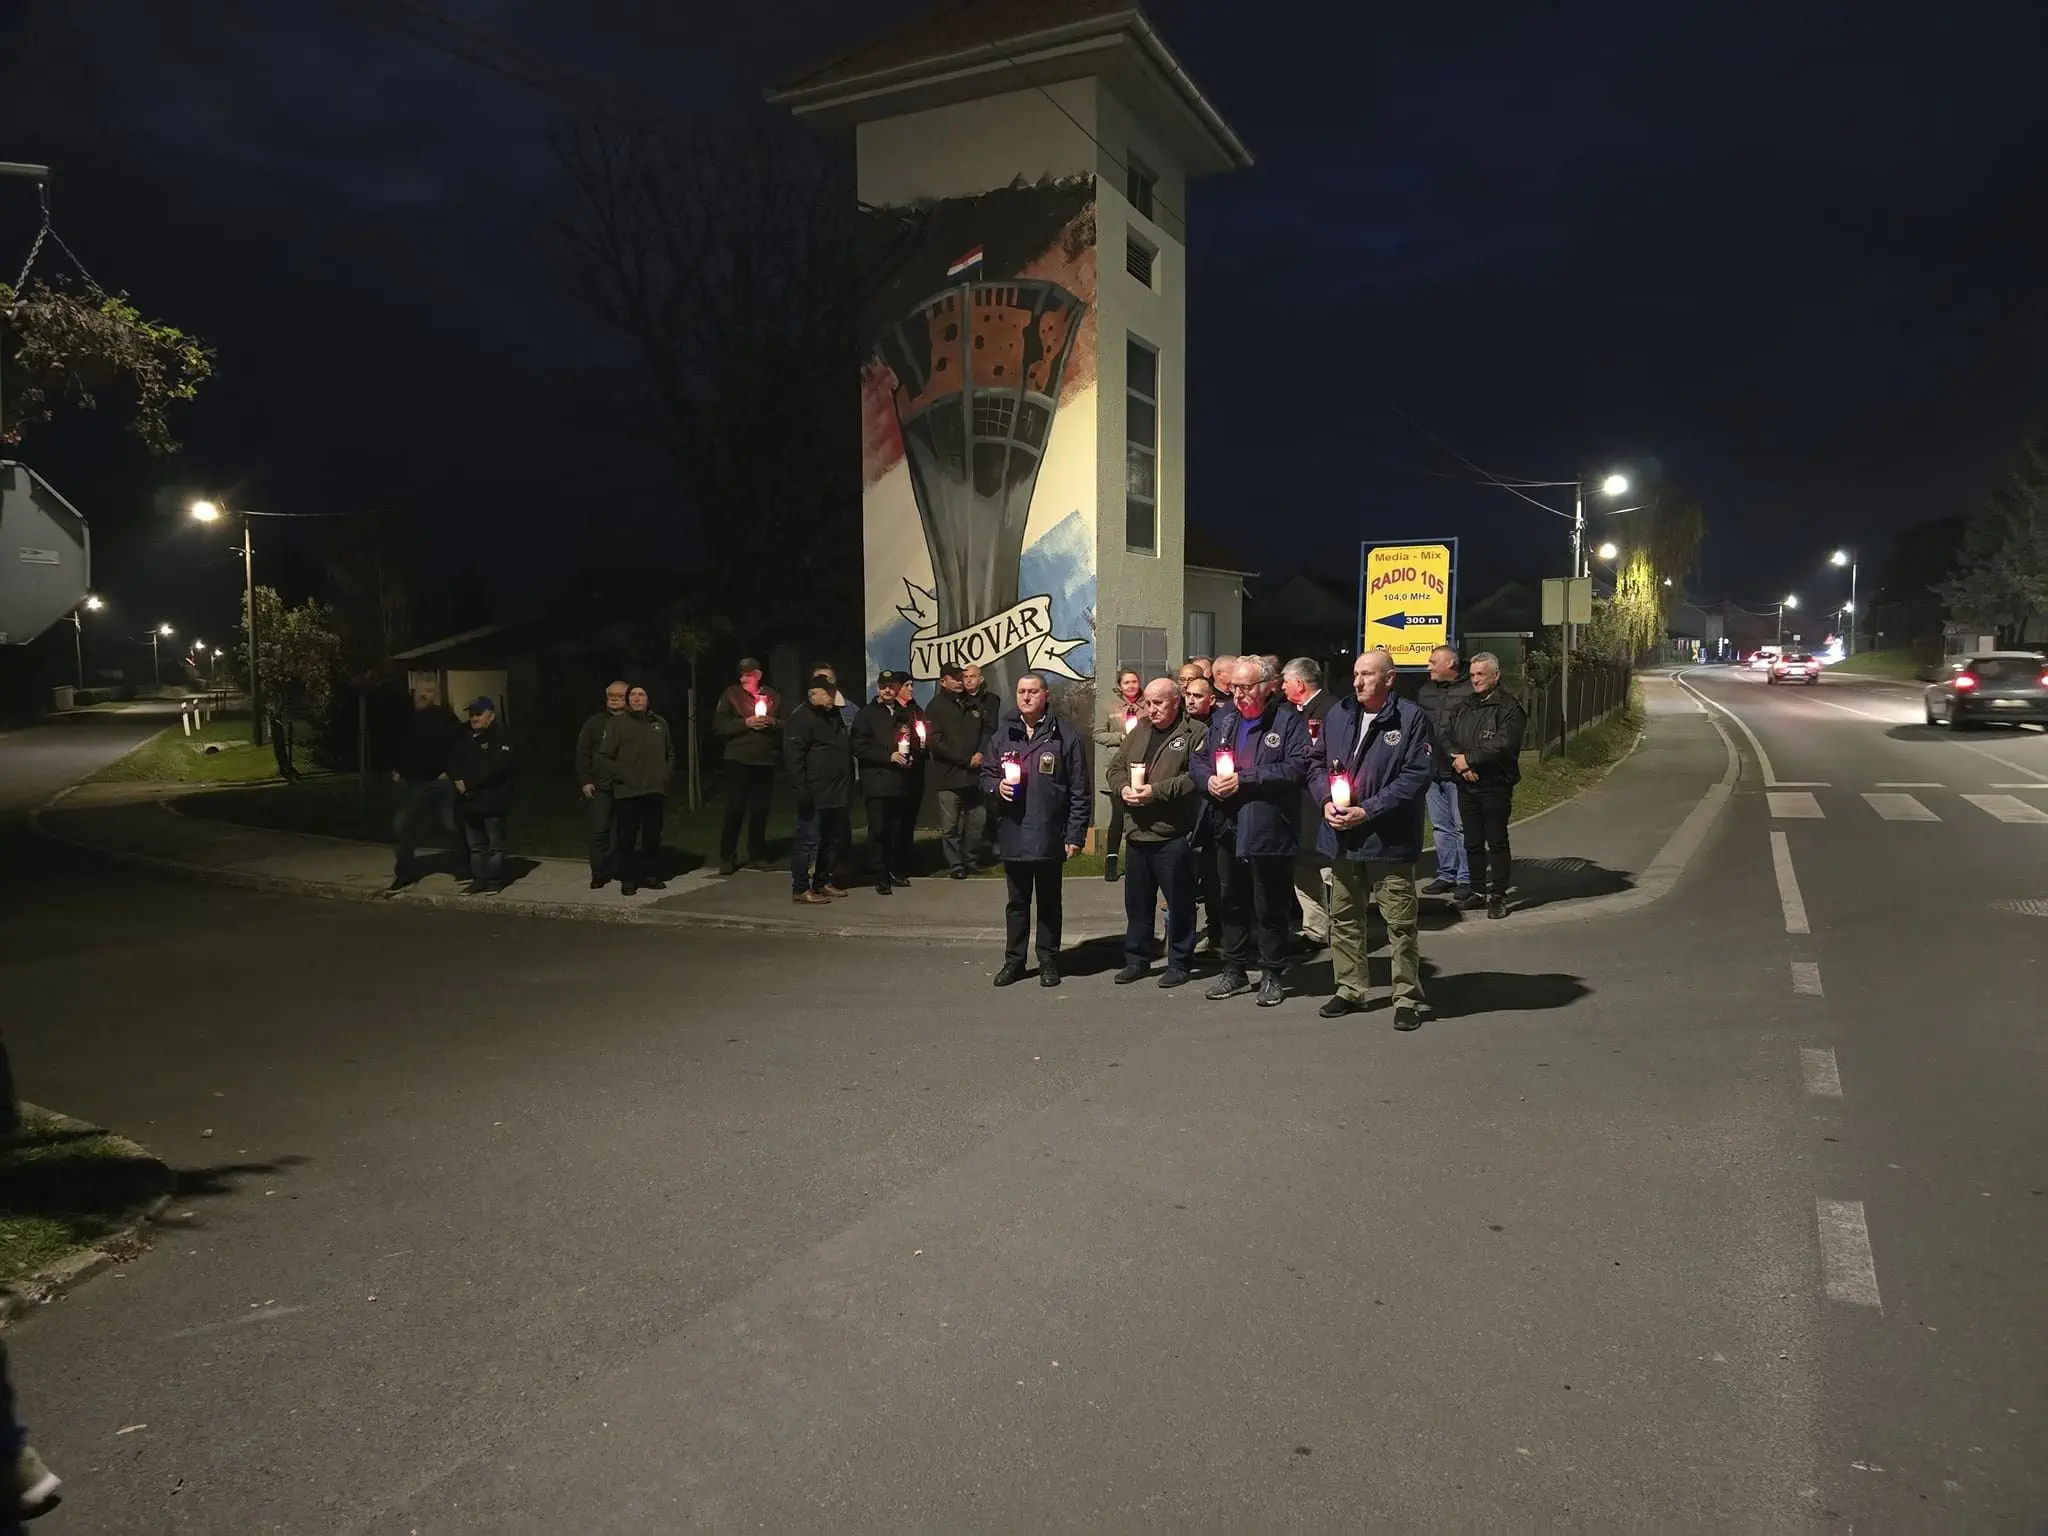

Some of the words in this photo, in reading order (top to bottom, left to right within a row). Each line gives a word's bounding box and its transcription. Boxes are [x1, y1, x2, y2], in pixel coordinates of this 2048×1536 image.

[1375, 553, 1409, 562] Media
[1421, 551, 1442, 560] Mix
[1371, 567, 1417, 595] RADIO
[1421, 570, 1444, 595] 105
[1410, 592, 1431, 600] MHz
[915, 607, 1044, 674] VUKOVAR
